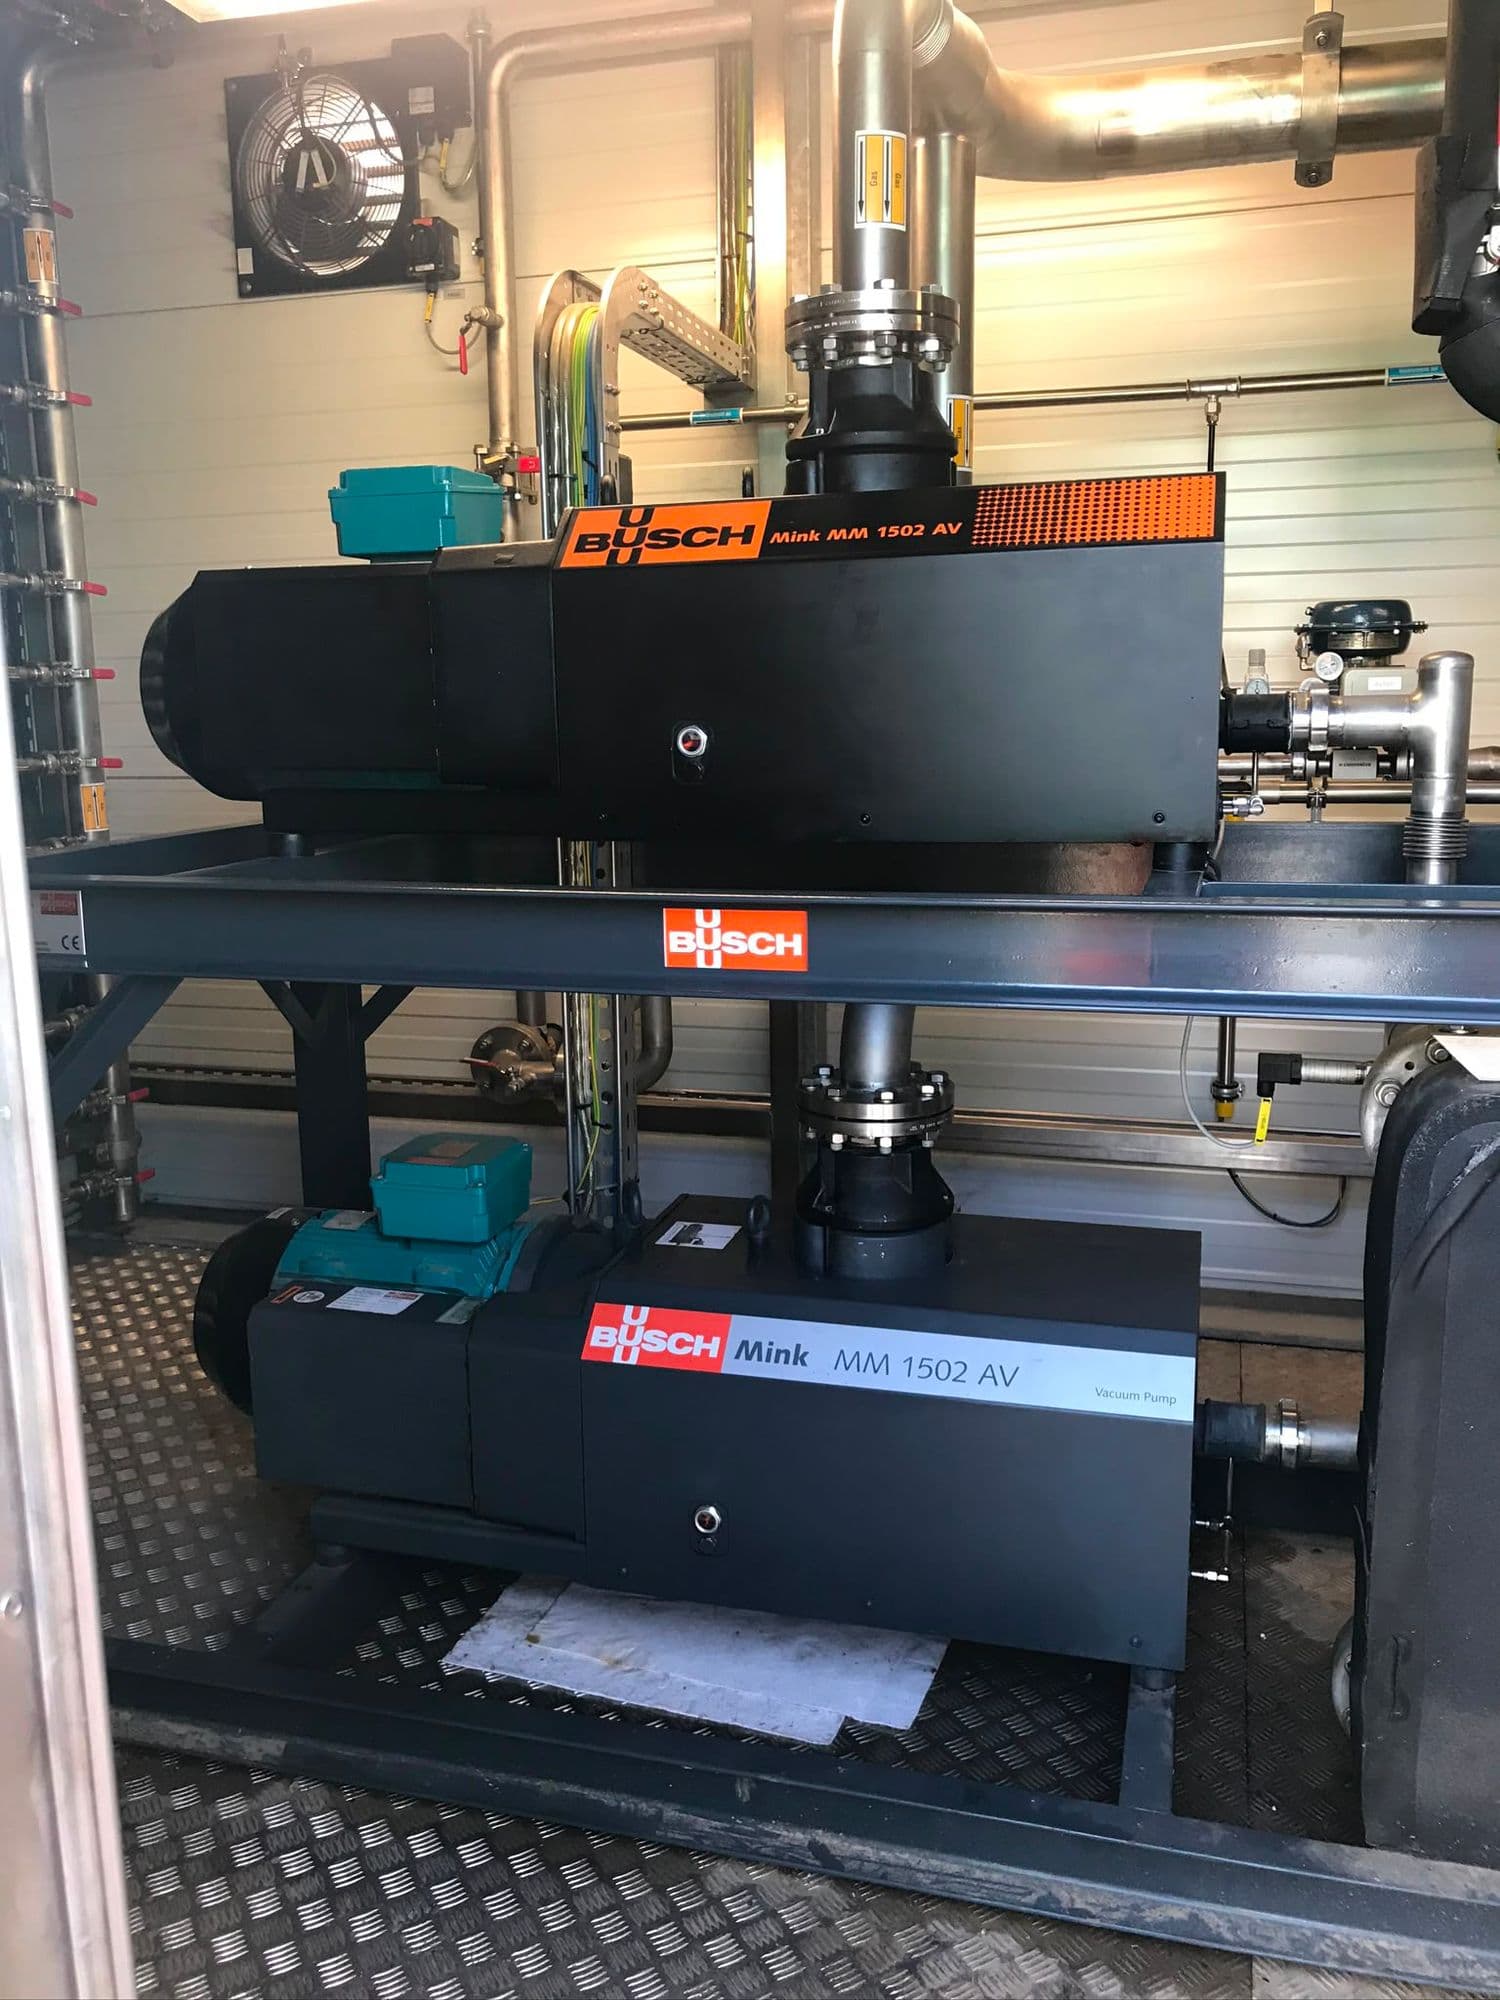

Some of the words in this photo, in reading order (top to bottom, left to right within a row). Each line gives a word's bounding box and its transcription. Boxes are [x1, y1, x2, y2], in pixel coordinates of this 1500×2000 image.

[870, 171, 878, 187] Gas
[573, 524, 756, 554] BUSCH
[769, 529, 822, 545] Mink
[826, 527, 869, 541] MM
[877, 523, 926, 538] 1502
[932, 522, 963, 536] AV
[61, 934, 80, 951] CE
[668, 928, 803, 957] BUSCH
[589, 1324, 721, 1358] BUSCH
[734, 1339, 810, 1368] Mink
[833, 1348, 890, 1376] MM
[902, 1355, 969, 1384] 1502
[978, 1363, 1020, 1388] AV
[1095, 1386, 1140, 1401] Vacuum
[1143, 1391, 1177, 1407] Pump
